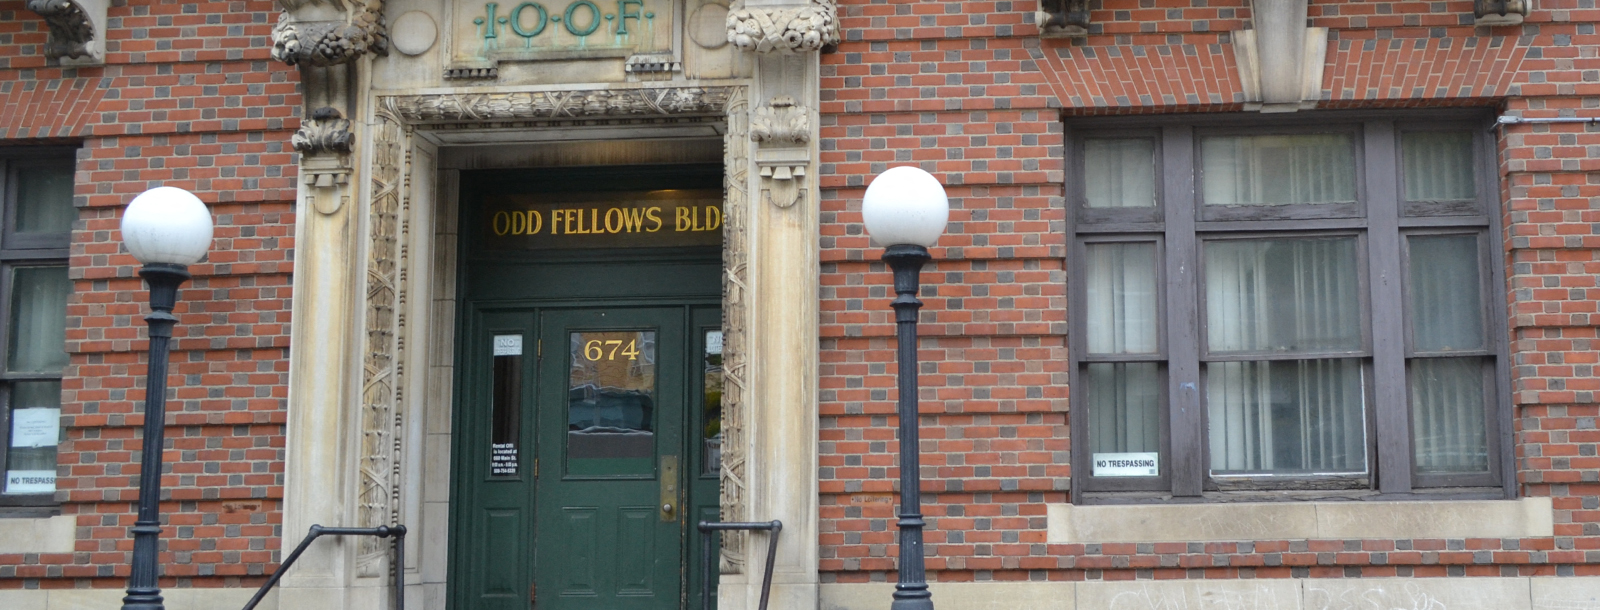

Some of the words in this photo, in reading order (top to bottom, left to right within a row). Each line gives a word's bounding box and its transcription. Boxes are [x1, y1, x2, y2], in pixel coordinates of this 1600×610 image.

[492, 209, 543, 236] ODD
[551, 206, 663, 235] FELLOWS
[675, 205, 724, 232] BLD
[584, 339, 640, 361] 674
[1108, 460, 1155, 468] TRESPASSING
[864, 496, 889, 504] Loitering
